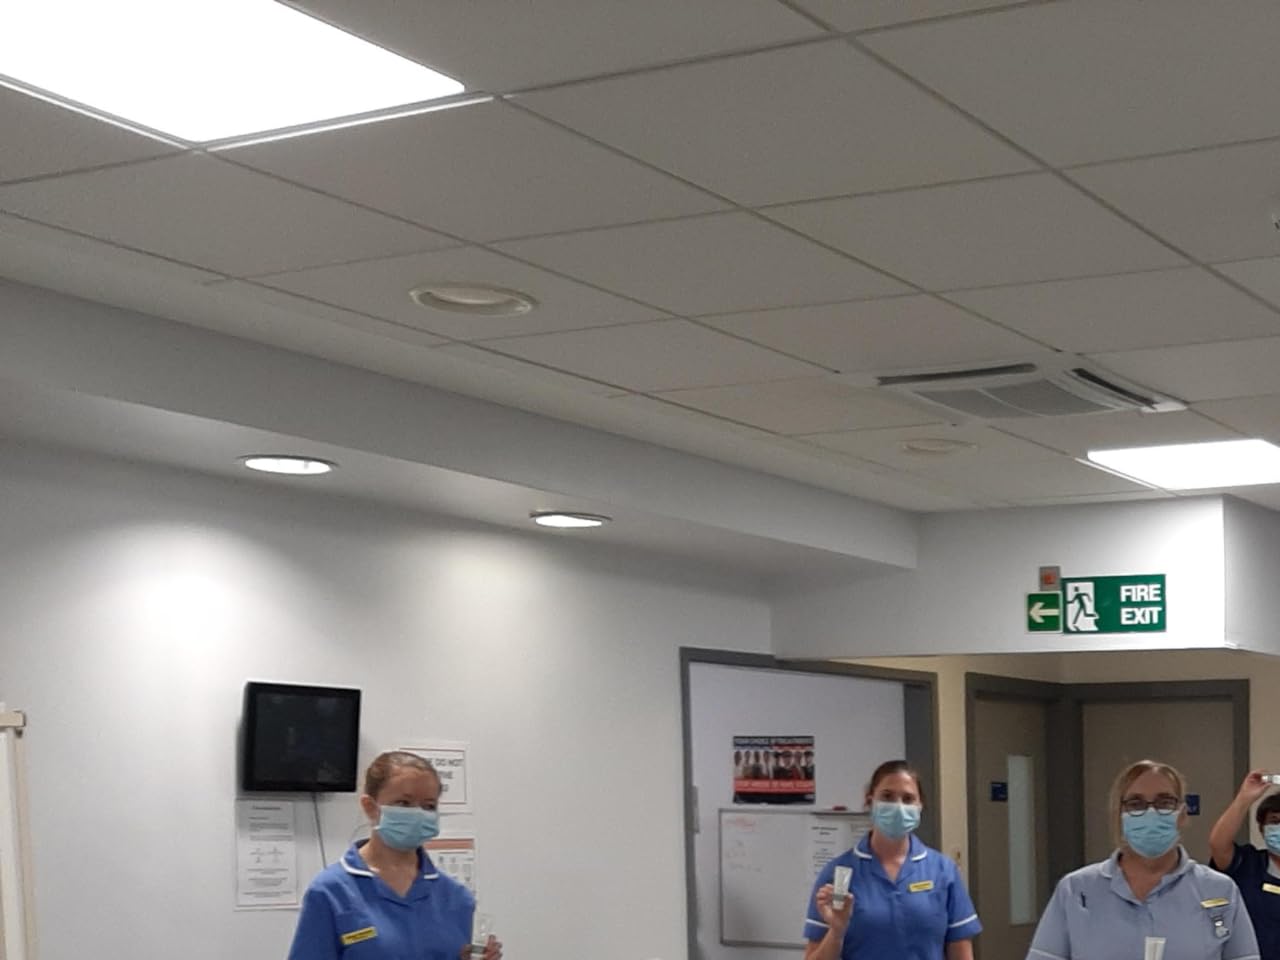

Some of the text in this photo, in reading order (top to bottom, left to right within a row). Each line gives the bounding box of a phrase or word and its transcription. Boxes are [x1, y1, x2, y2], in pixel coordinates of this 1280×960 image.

[1120, 584, 1161, 602] FIRE
[1120, 606, 1162, 625] EXIT
[448, 759, 463, 767] NOT
